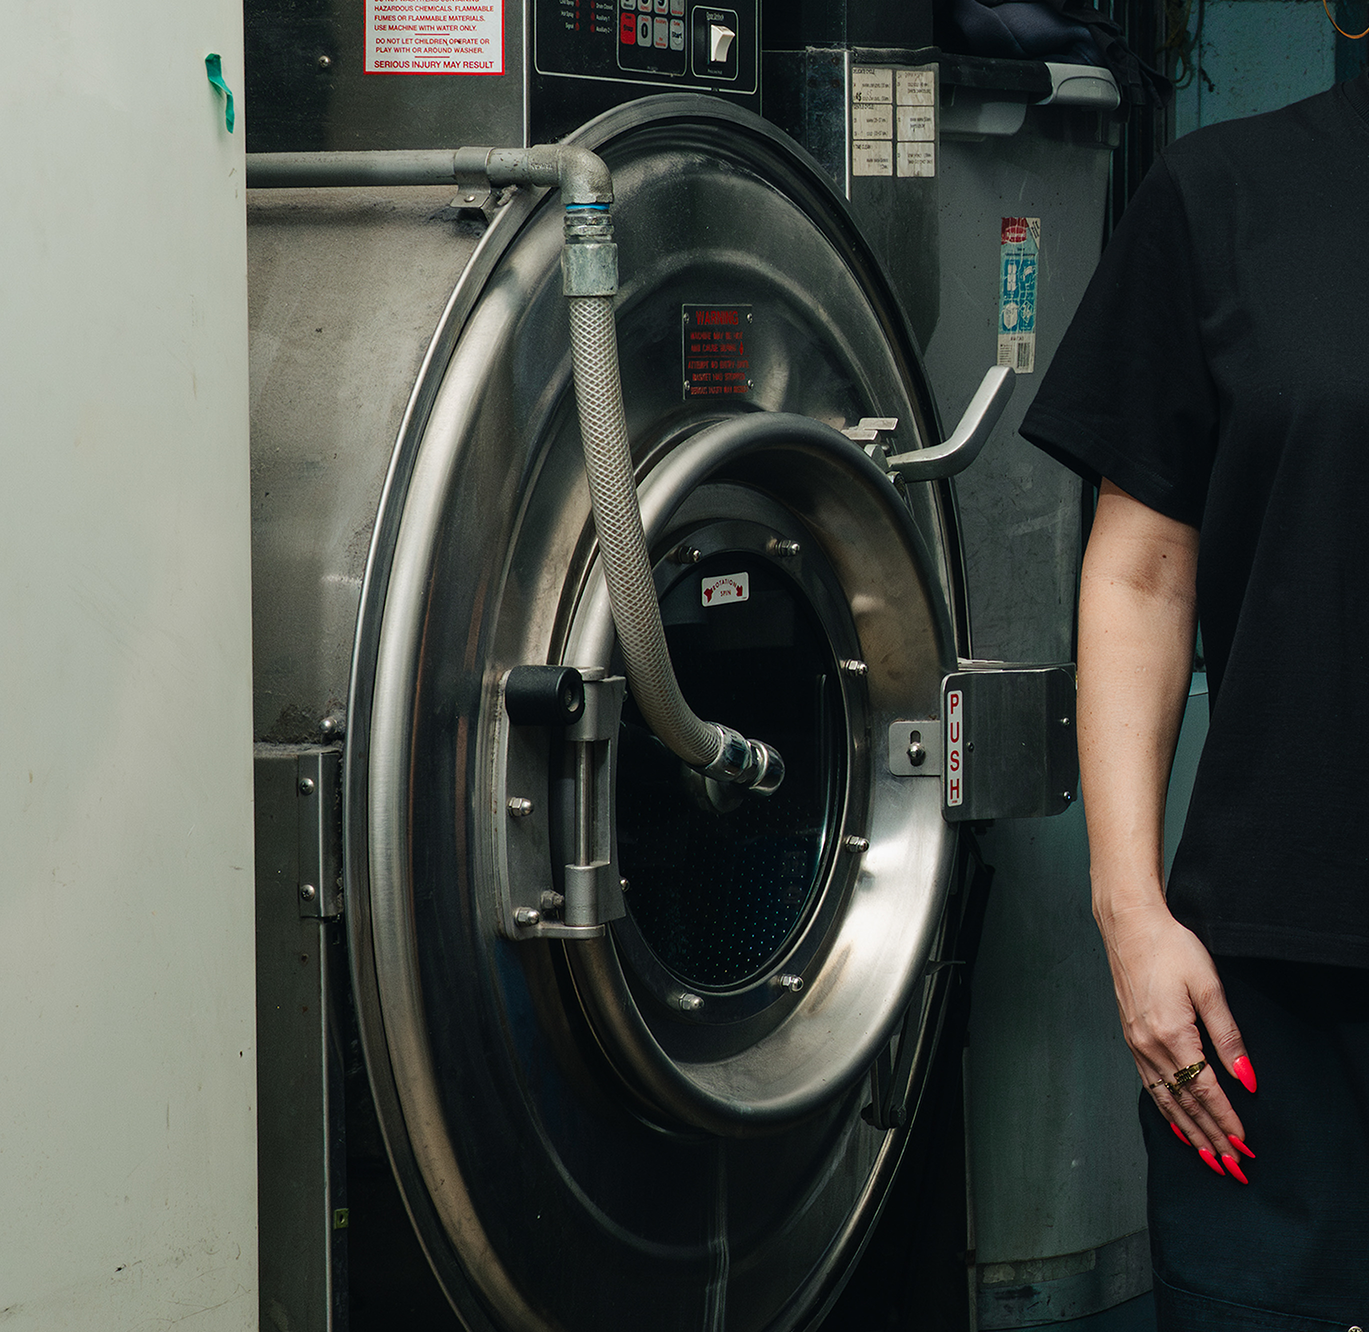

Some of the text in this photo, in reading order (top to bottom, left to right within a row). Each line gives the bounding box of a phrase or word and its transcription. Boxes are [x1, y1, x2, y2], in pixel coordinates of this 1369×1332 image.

[641, 22, 648, 39] 0
[374, 61, 495, 69] SERIOUS INJURY MAY RESULT
[695, 310, 739, 325] WARNING
[950, 693, 960, 800] PUSH
